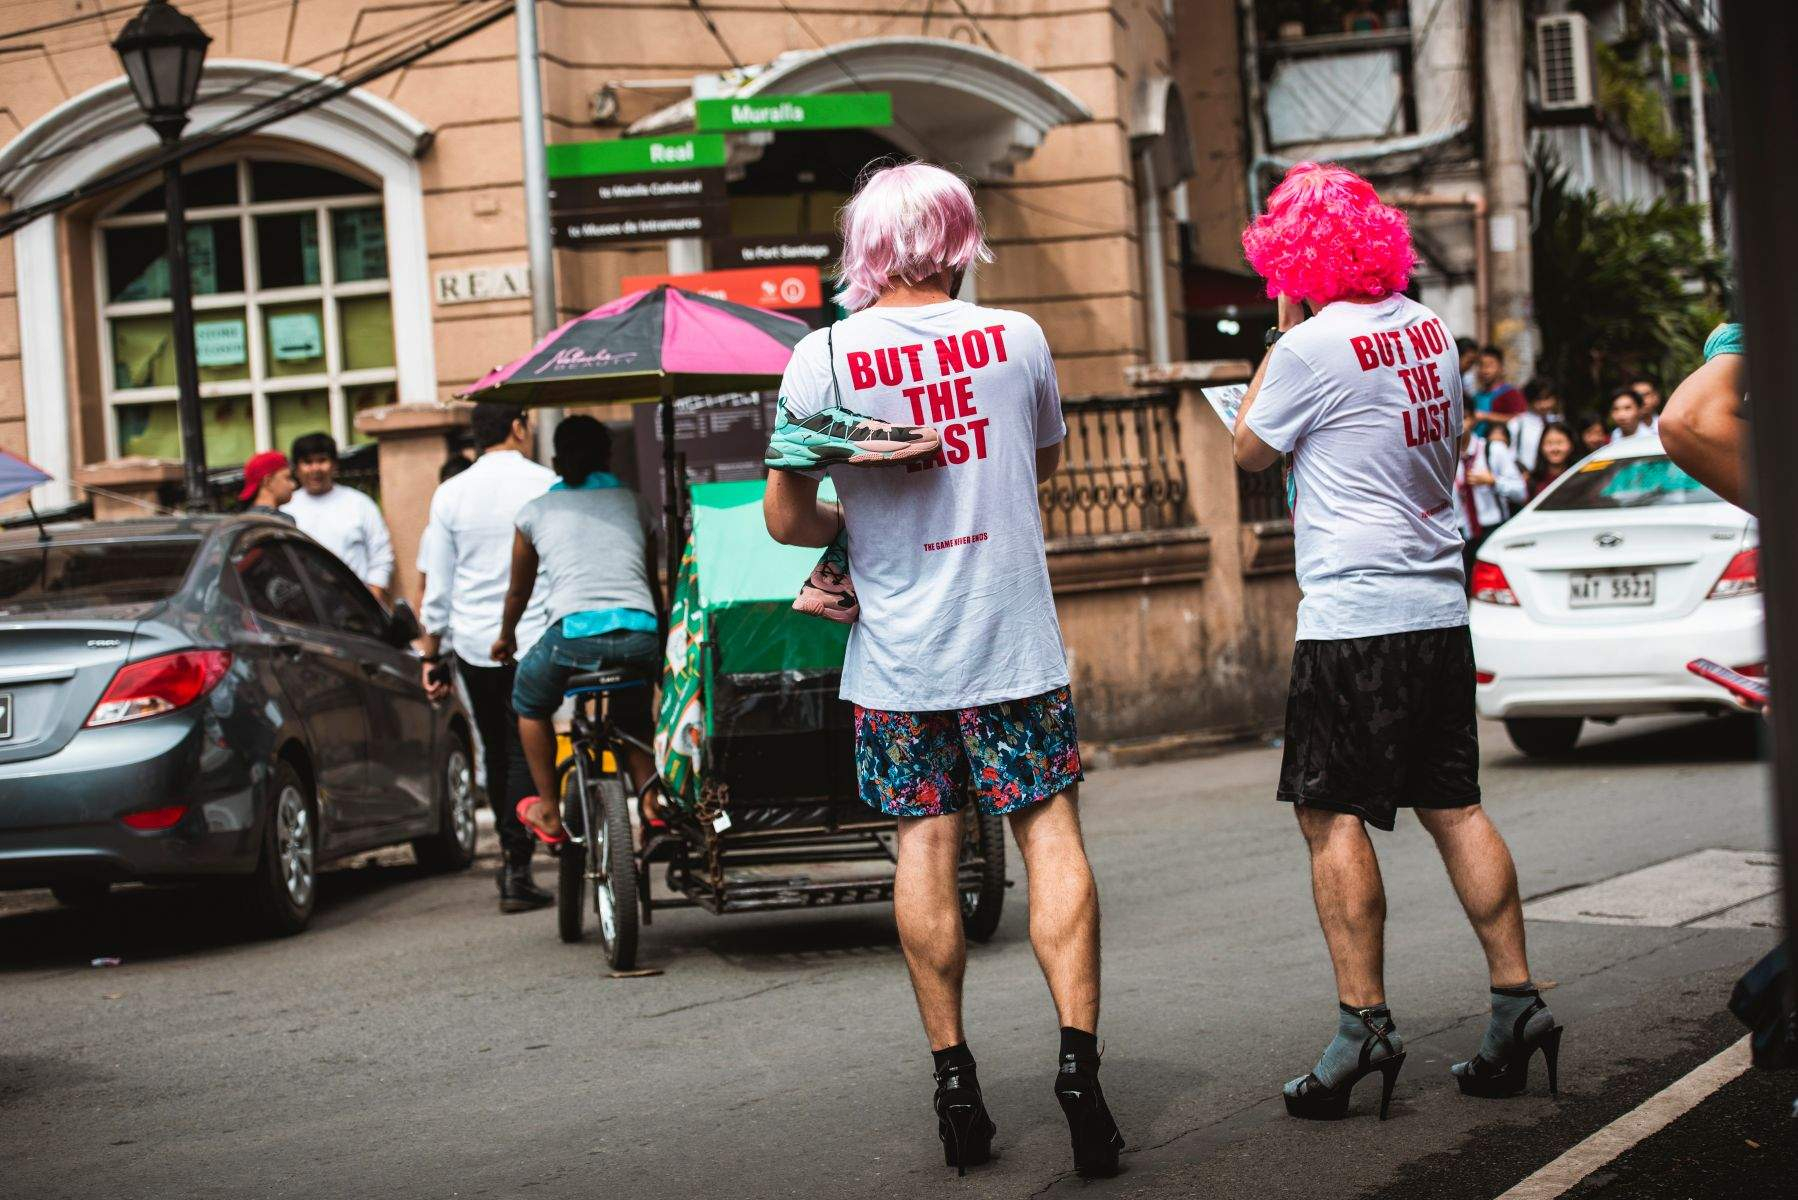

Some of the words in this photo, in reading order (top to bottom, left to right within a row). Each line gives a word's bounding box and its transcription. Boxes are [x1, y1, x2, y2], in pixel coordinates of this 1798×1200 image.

[650, 139, 694, 163] Real
[599, 186, 612, 199] to
[650, 179, 703, 196] Cathedral
[568, 225, 581, 238] to
[622, 219, 638, 234] de
[638, 217, 702, 232] Intramuros
[741, 247, 755, 260] to
[755, 246, 779, 259] Fort
[780, 244, 830, 259] Santiago
[846, 343, 924, 391] BUT
[934, 324, 1008, 377] NOT
[1350, 331, 1407, 372] BUT
[1397, 362, 1444, 405] THE
[902, 376, 978, 427] THE
[1402, 401, 1451, 448] LAST
[923, 543, 935, 552] THE
[935, 539, 954, 550] GAME
[971, 532, 988, 543] ENDS
